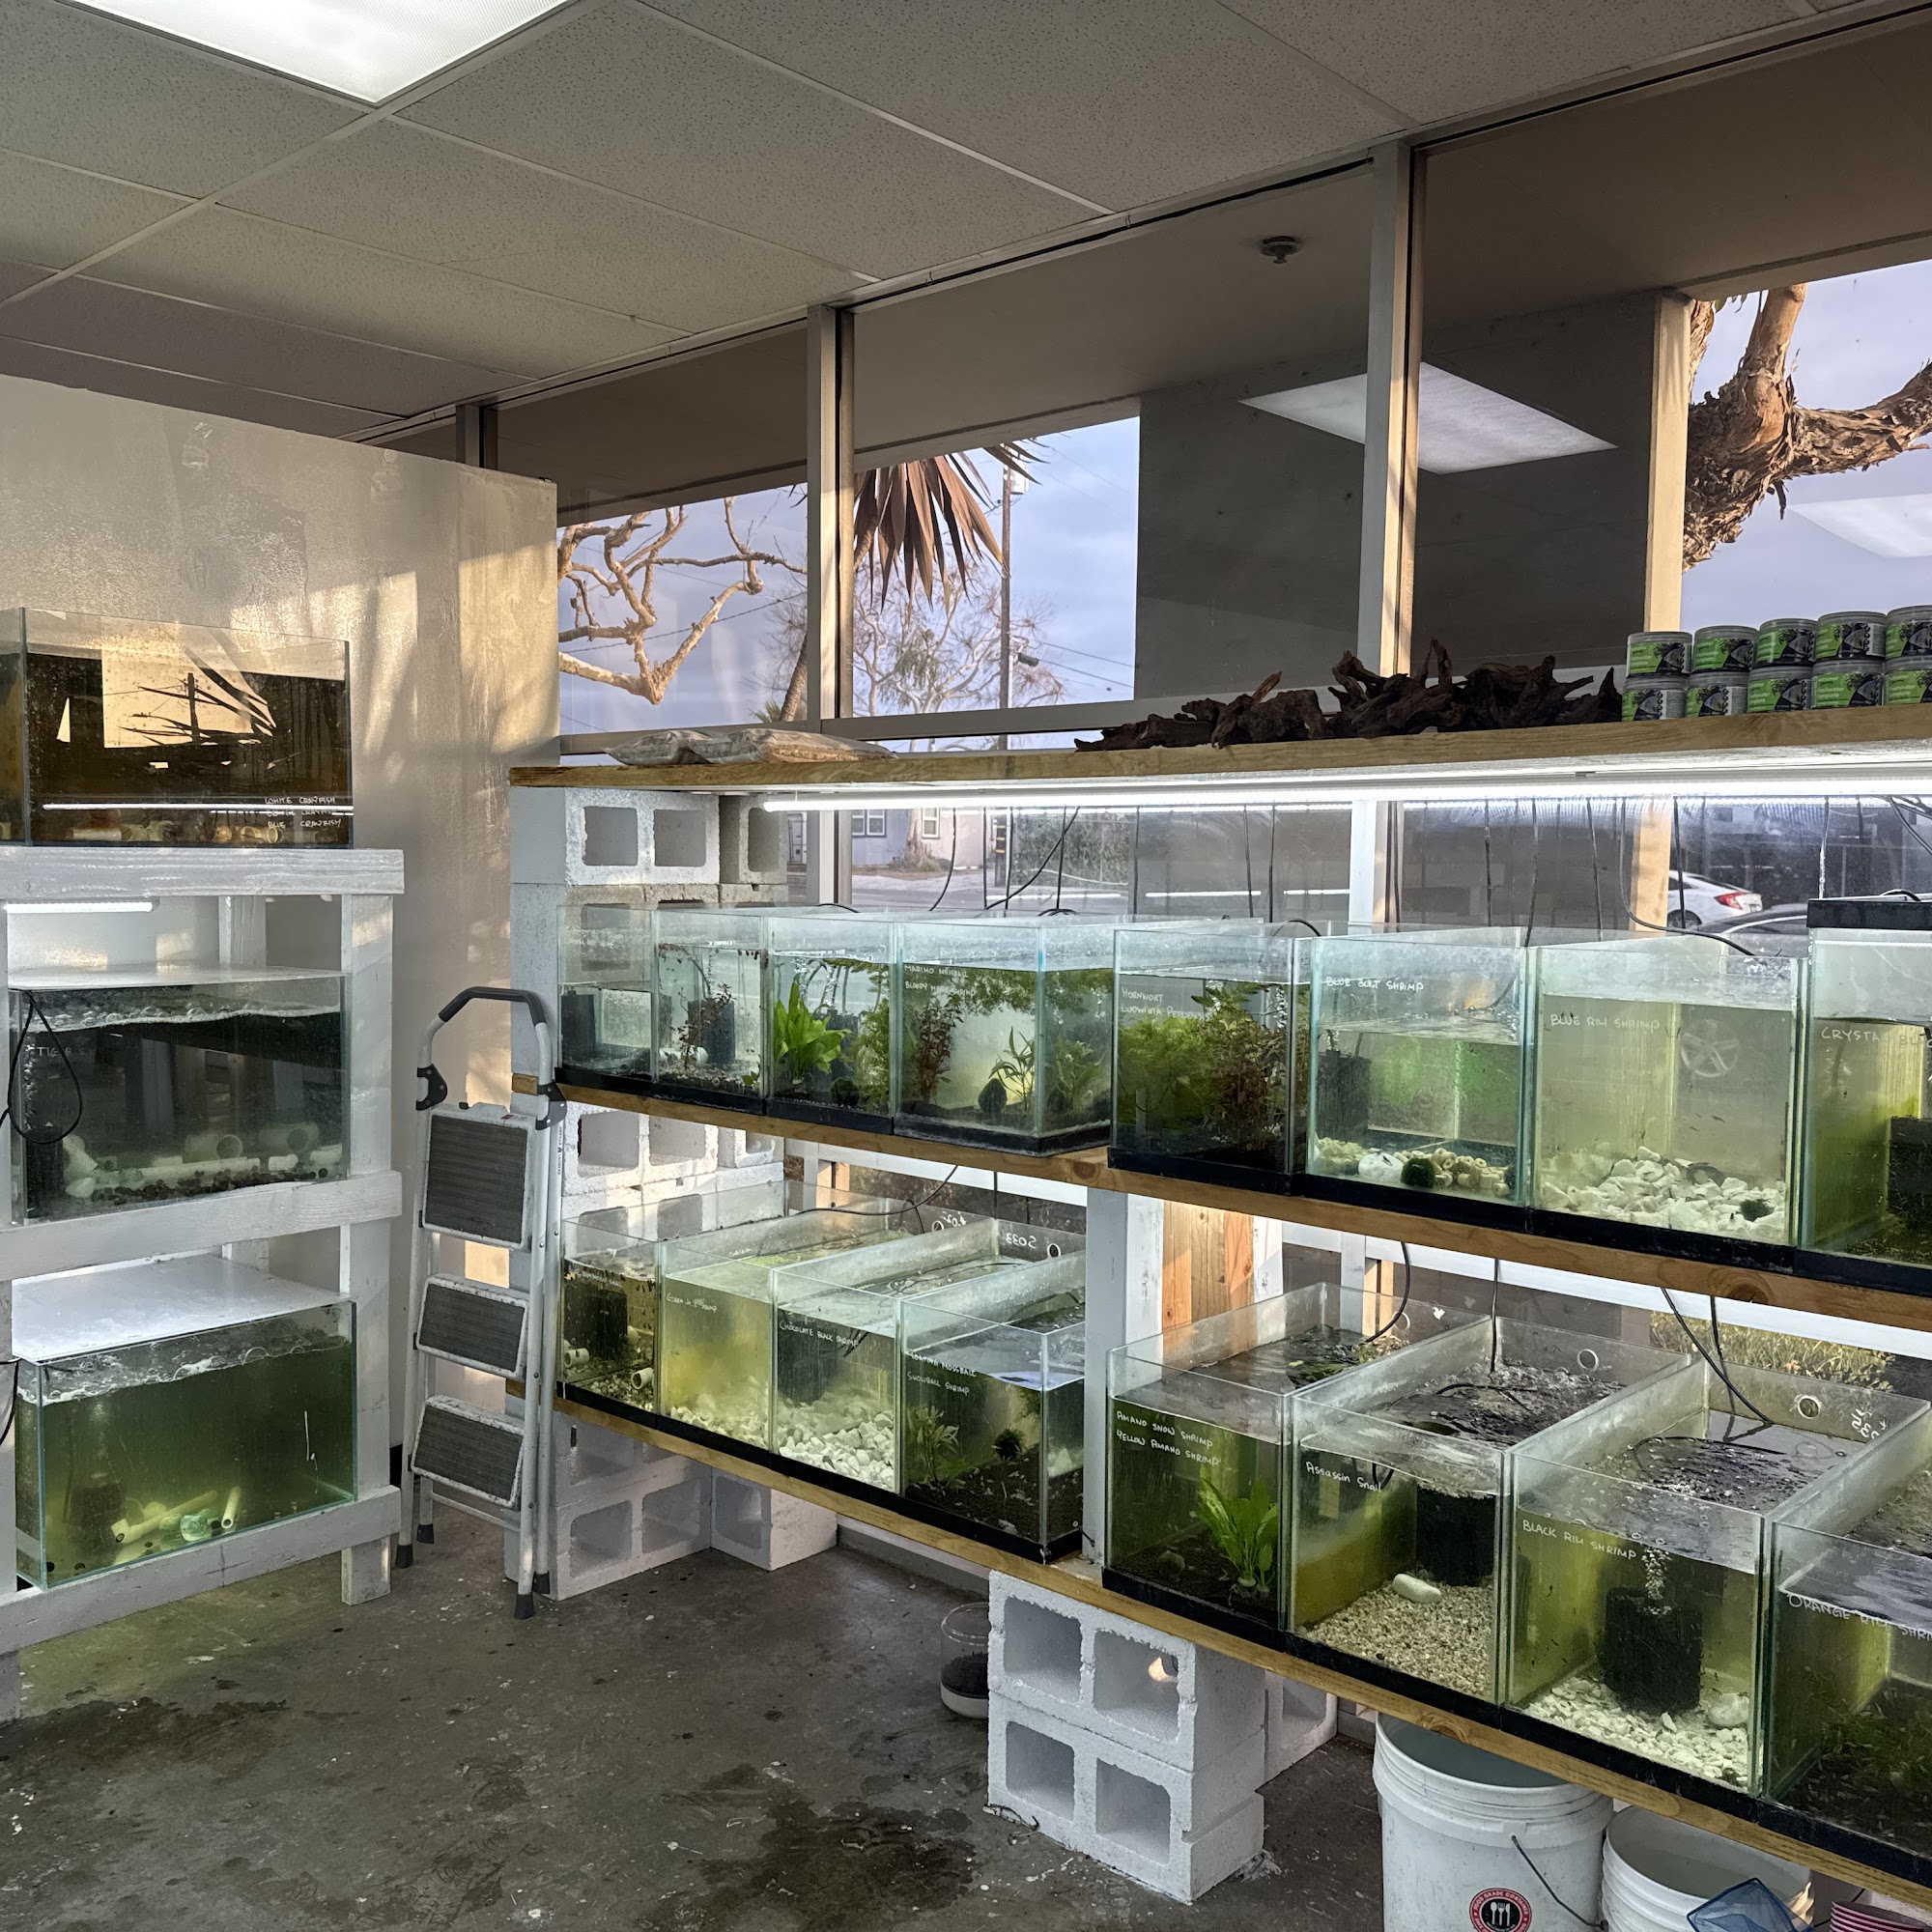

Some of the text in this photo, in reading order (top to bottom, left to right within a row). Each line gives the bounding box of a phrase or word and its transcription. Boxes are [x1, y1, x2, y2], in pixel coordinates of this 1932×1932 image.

[300, 819, 341, 828] CRAYFISH
[904, 965, 934, 974] MARIMO
[1326, 977, 1350, 987] BLUE
[1386, 980, 1424, 993] SHRIMP
[1122, 988, 1163, 1003] HORNWORT
[1550, 1014, 1580, 1026] BLUE
[1614, 1018, 1660, 1034] SHRIMP
[1821, 1026, 1882, 1042] CRYSTA
[37, 1046, 72, 1057] TIGR
[780, 1320, 813, 1336] CHOCOLATE
[907, 1370, 970, 1397] SNOWBALL SHRIMP
[1116, 1410, 1213, 1450] AMANO SNOW SHRIMP
[1116, 1429, 1220, 1467] YELLOW AMANO SHRIMP
[1305, 1461, 1382, 1493] Assassin Snail
[1522, 1519, 1558, 1539] BLACK
[1589, 1540, 1637, 1561] SHRIMP
[1787, 1592, 1851, 1620] ORANGE
[1473, 1896, 1485, 1910] FOOD
